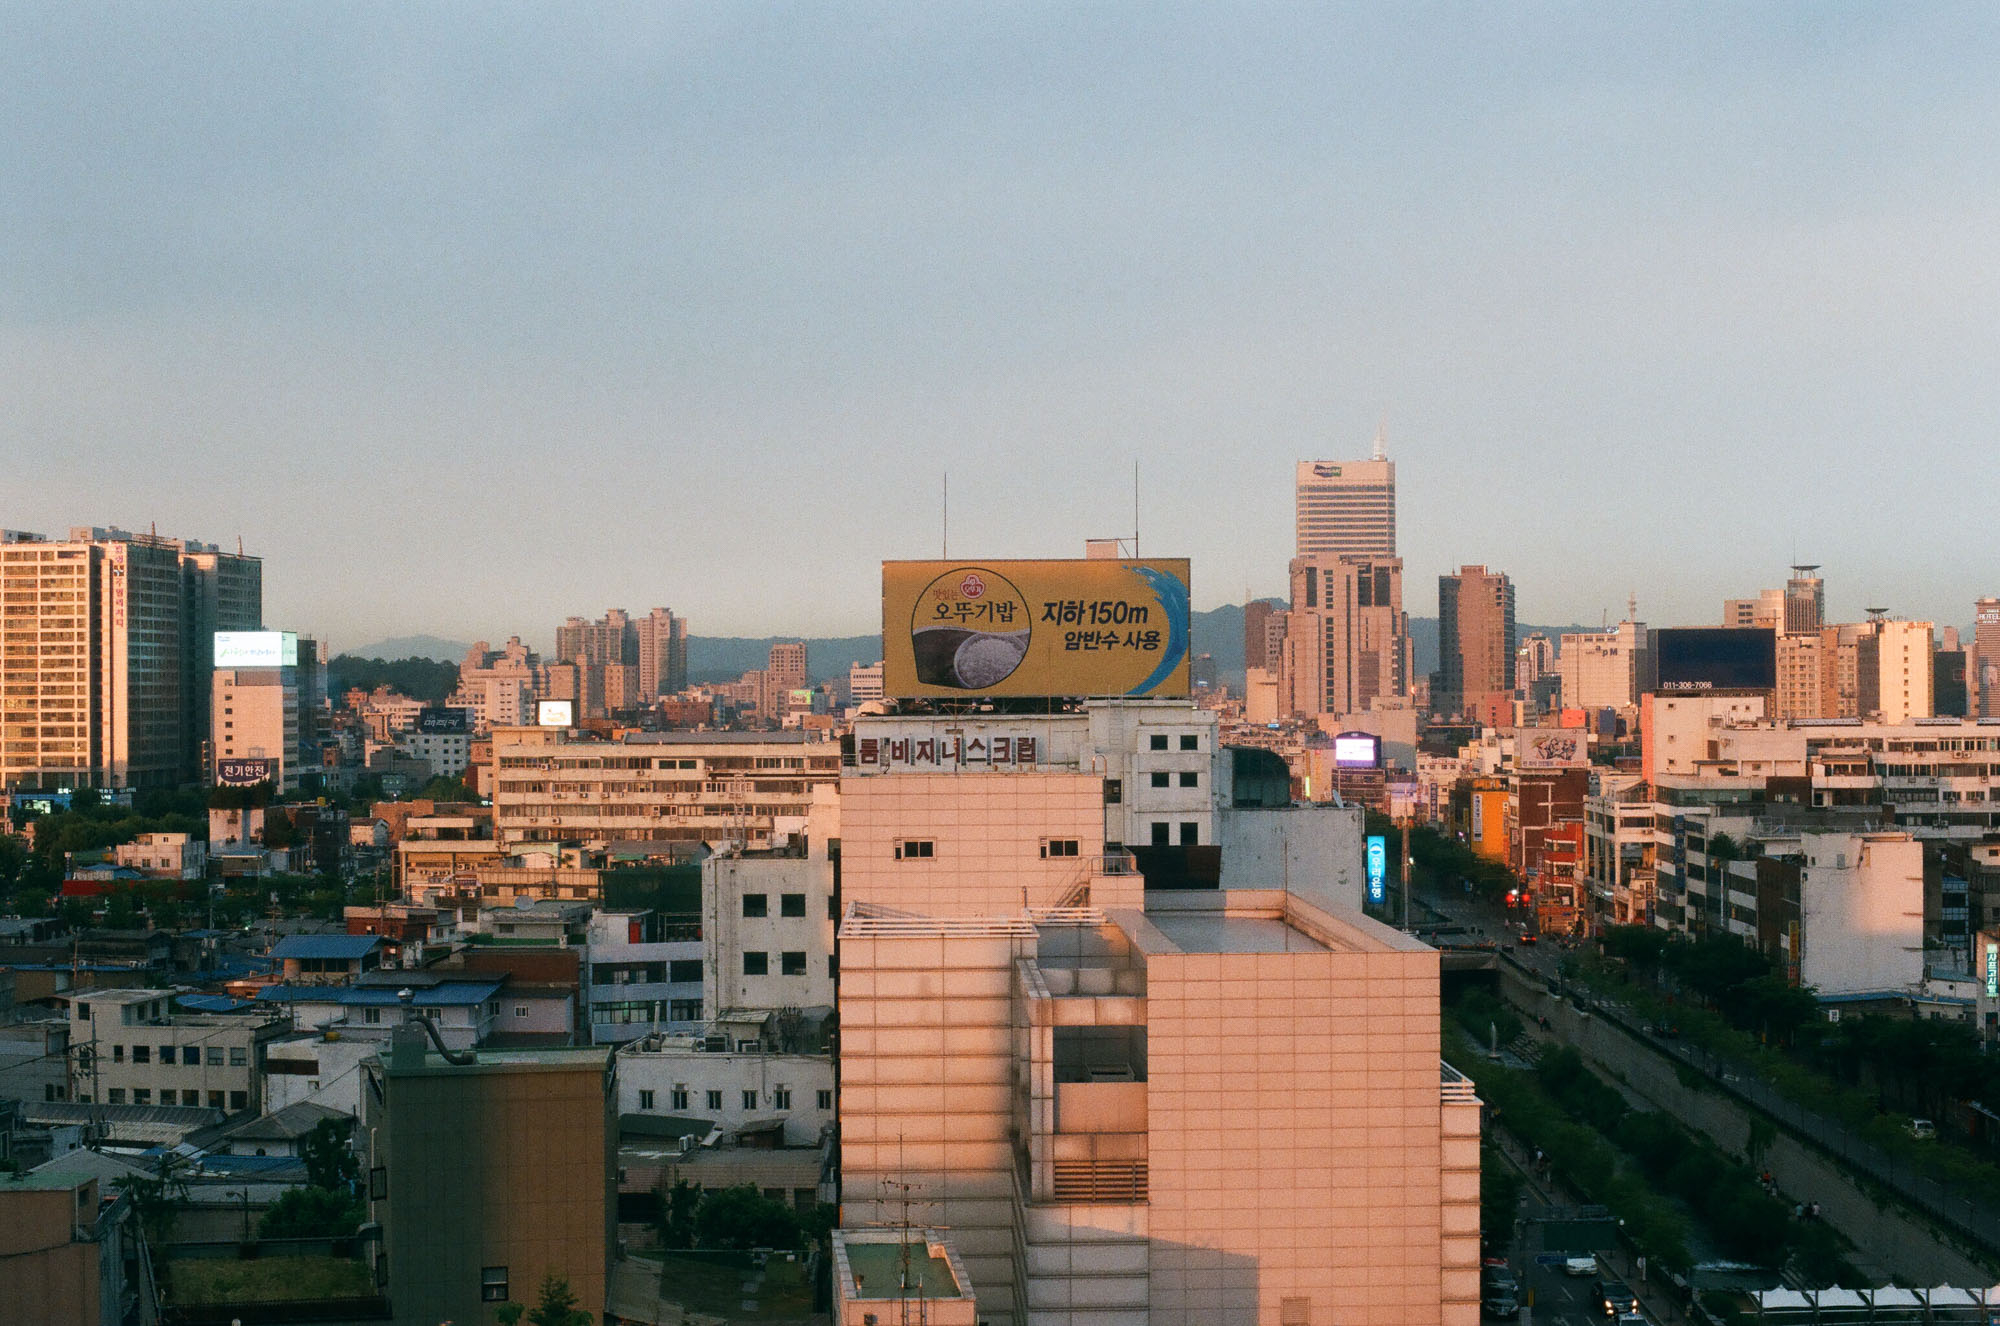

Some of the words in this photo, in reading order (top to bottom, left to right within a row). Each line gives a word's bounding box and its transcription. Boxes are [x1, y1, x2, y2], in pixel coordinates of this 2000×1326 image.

[932, 600, 1018, 623] 오뚜기밥
[1041, 600, 1086, 626] 지하
[1088, 600, 1149, 625] 150m
[1064, 630, 1120, 651] 암반수
[1122, 630, 1161, 651] 사용
[224, 765, 265, 777] 전기안전
[1371, 857, 1382, 899] 우리은행
